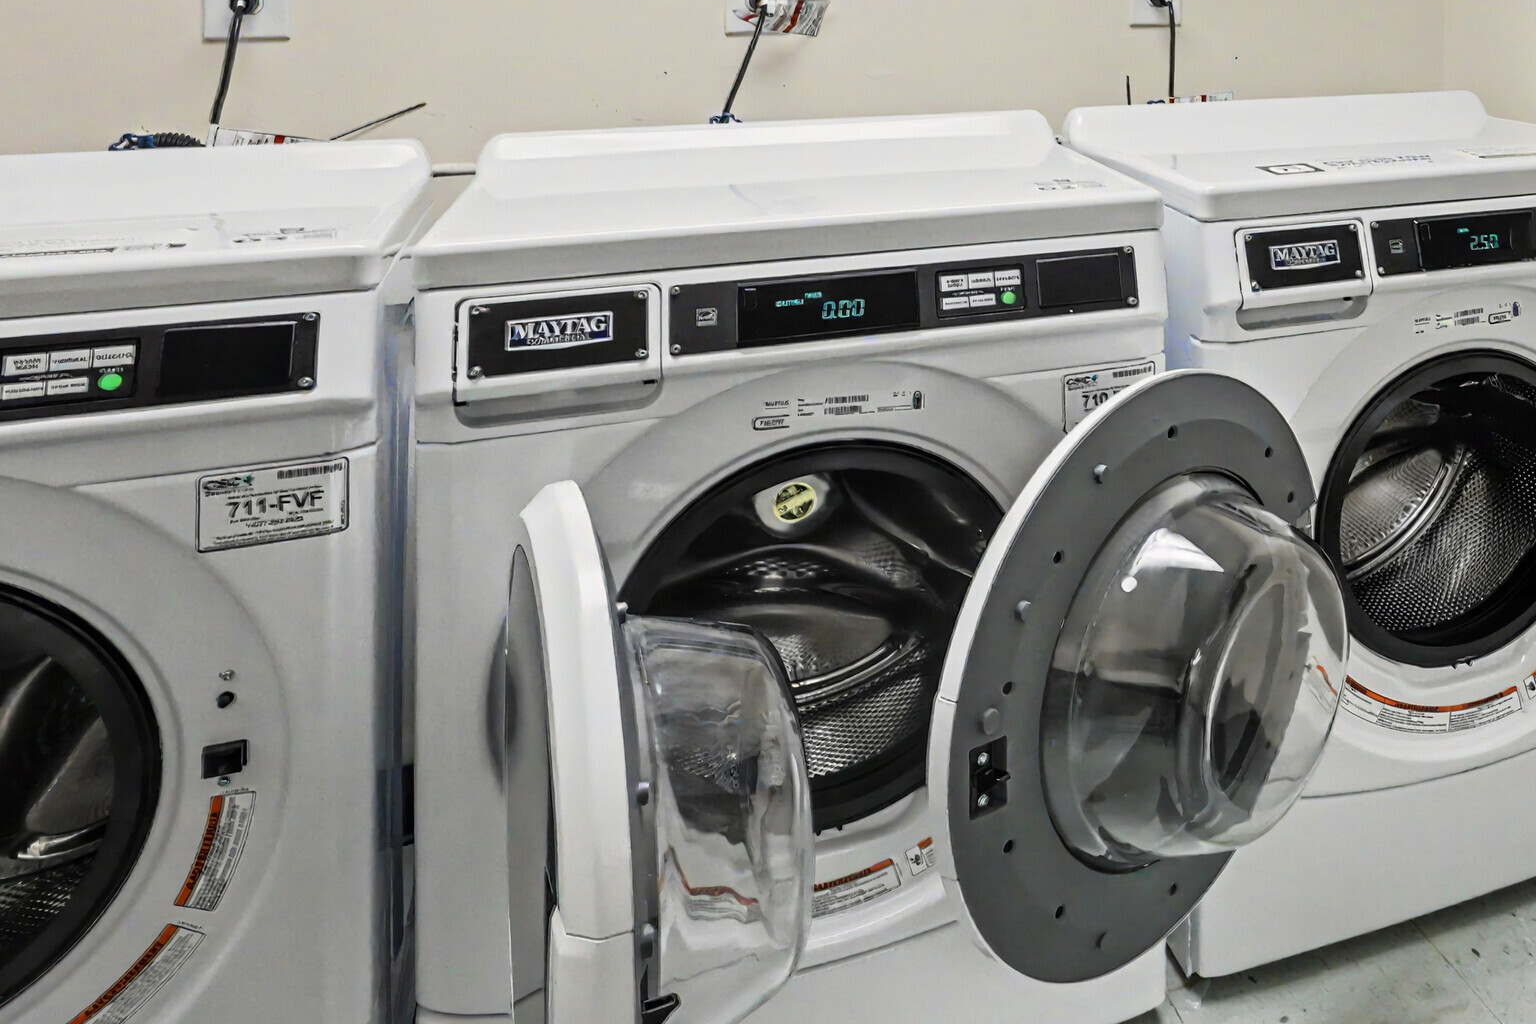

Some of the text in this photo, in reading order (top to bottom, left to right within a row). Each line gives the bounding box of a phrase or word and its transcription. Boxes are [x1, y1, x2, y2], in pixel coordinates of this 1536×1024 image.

[1274, 244, 1336, 261] MAYTAG
[511, 317, 607, 340] MAYTAG
[225, 490, 324, 518] 711-FVF
